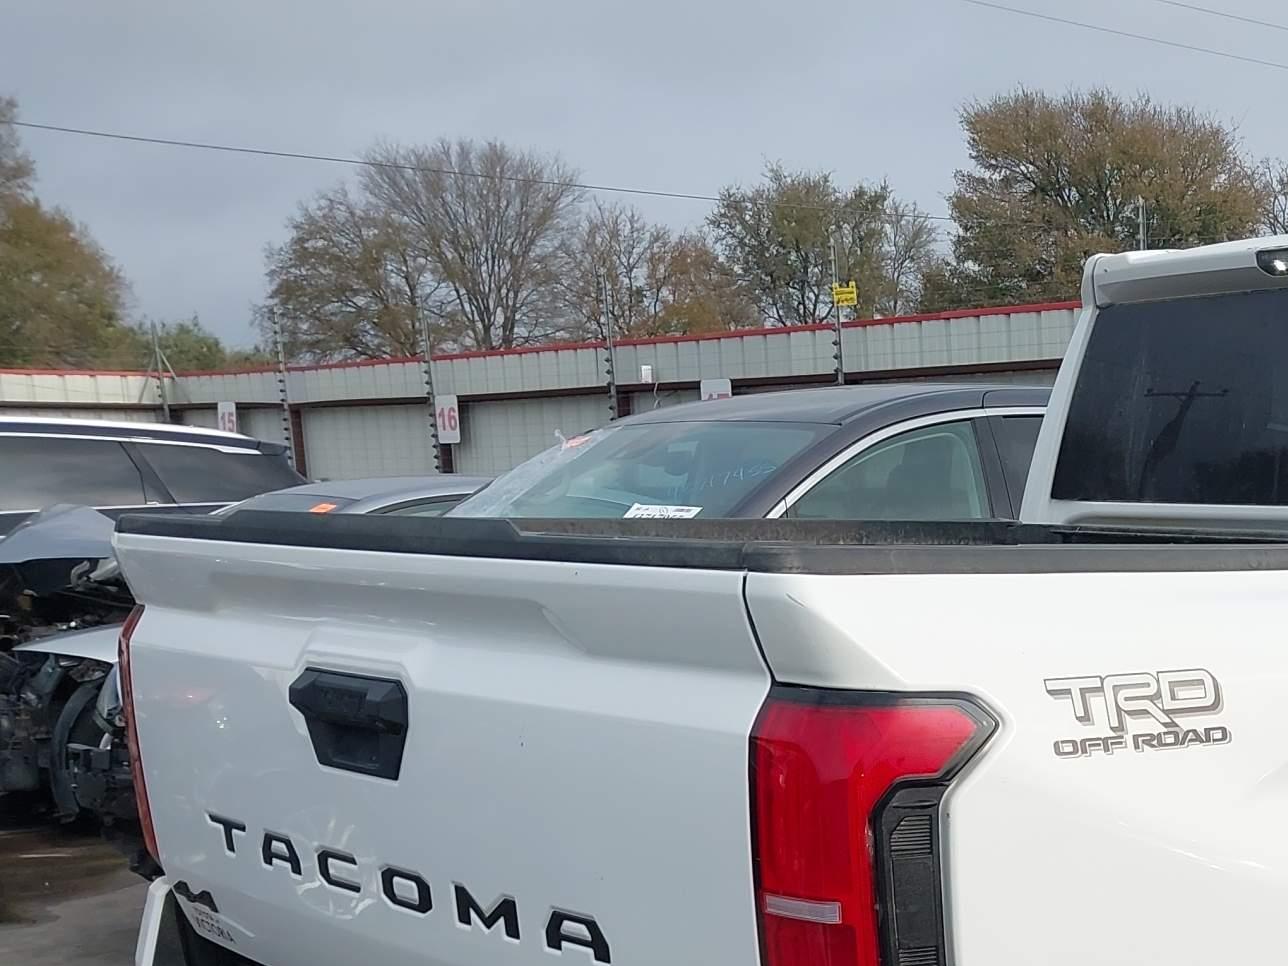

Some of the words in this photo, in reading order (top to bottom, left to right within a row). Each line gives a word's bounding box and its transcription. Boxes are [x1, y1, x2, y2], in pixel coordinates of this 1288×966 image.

[220, 411, 235, 433] 15
[438, 407, 458, 431] 16
[1043, 668, 1226, 736] TRD
[1053, 735, 1127, 759] OFF
[1133, 726, 1233, 753] ROAD
[206, 811, 613, 966] TACOMA
